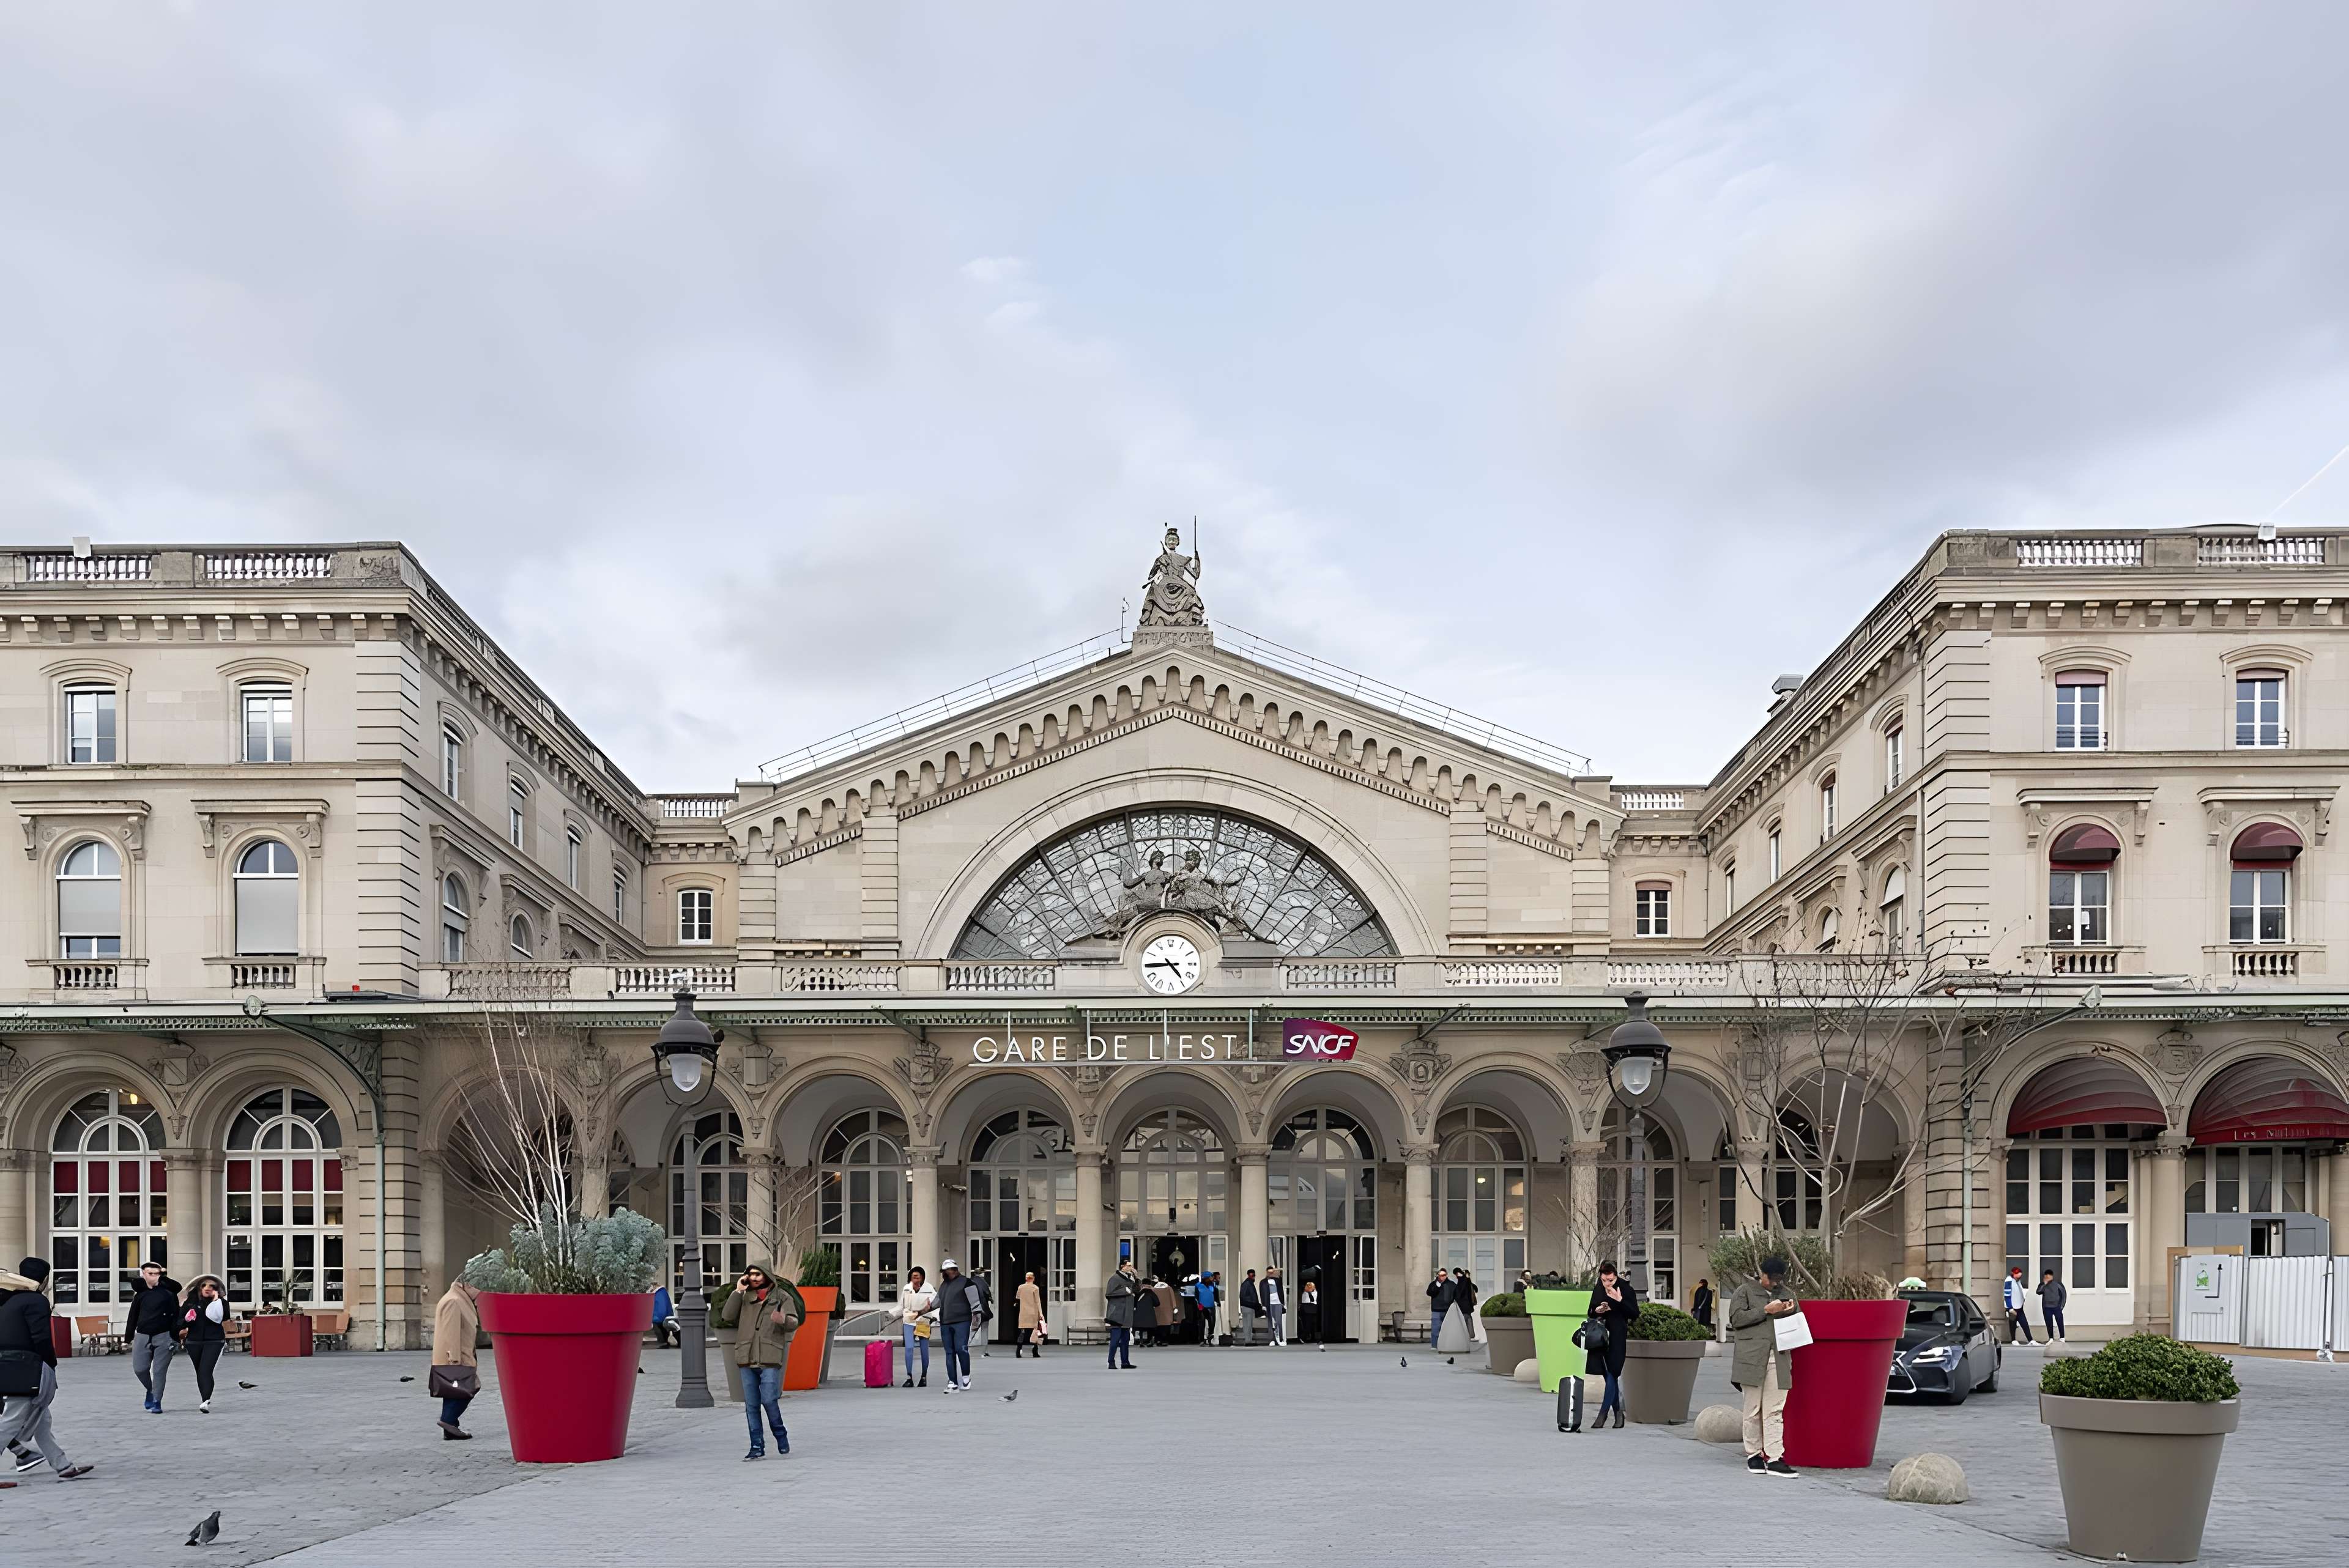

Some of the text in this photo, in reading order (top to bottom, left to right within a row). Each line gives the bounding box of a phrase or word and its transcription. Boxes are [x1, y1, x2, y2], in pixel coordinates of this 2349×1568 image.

[973, 1035, 1237, 1063] GARE DE L'EST
[1286, 1034, 1354, 1054] SNCF
